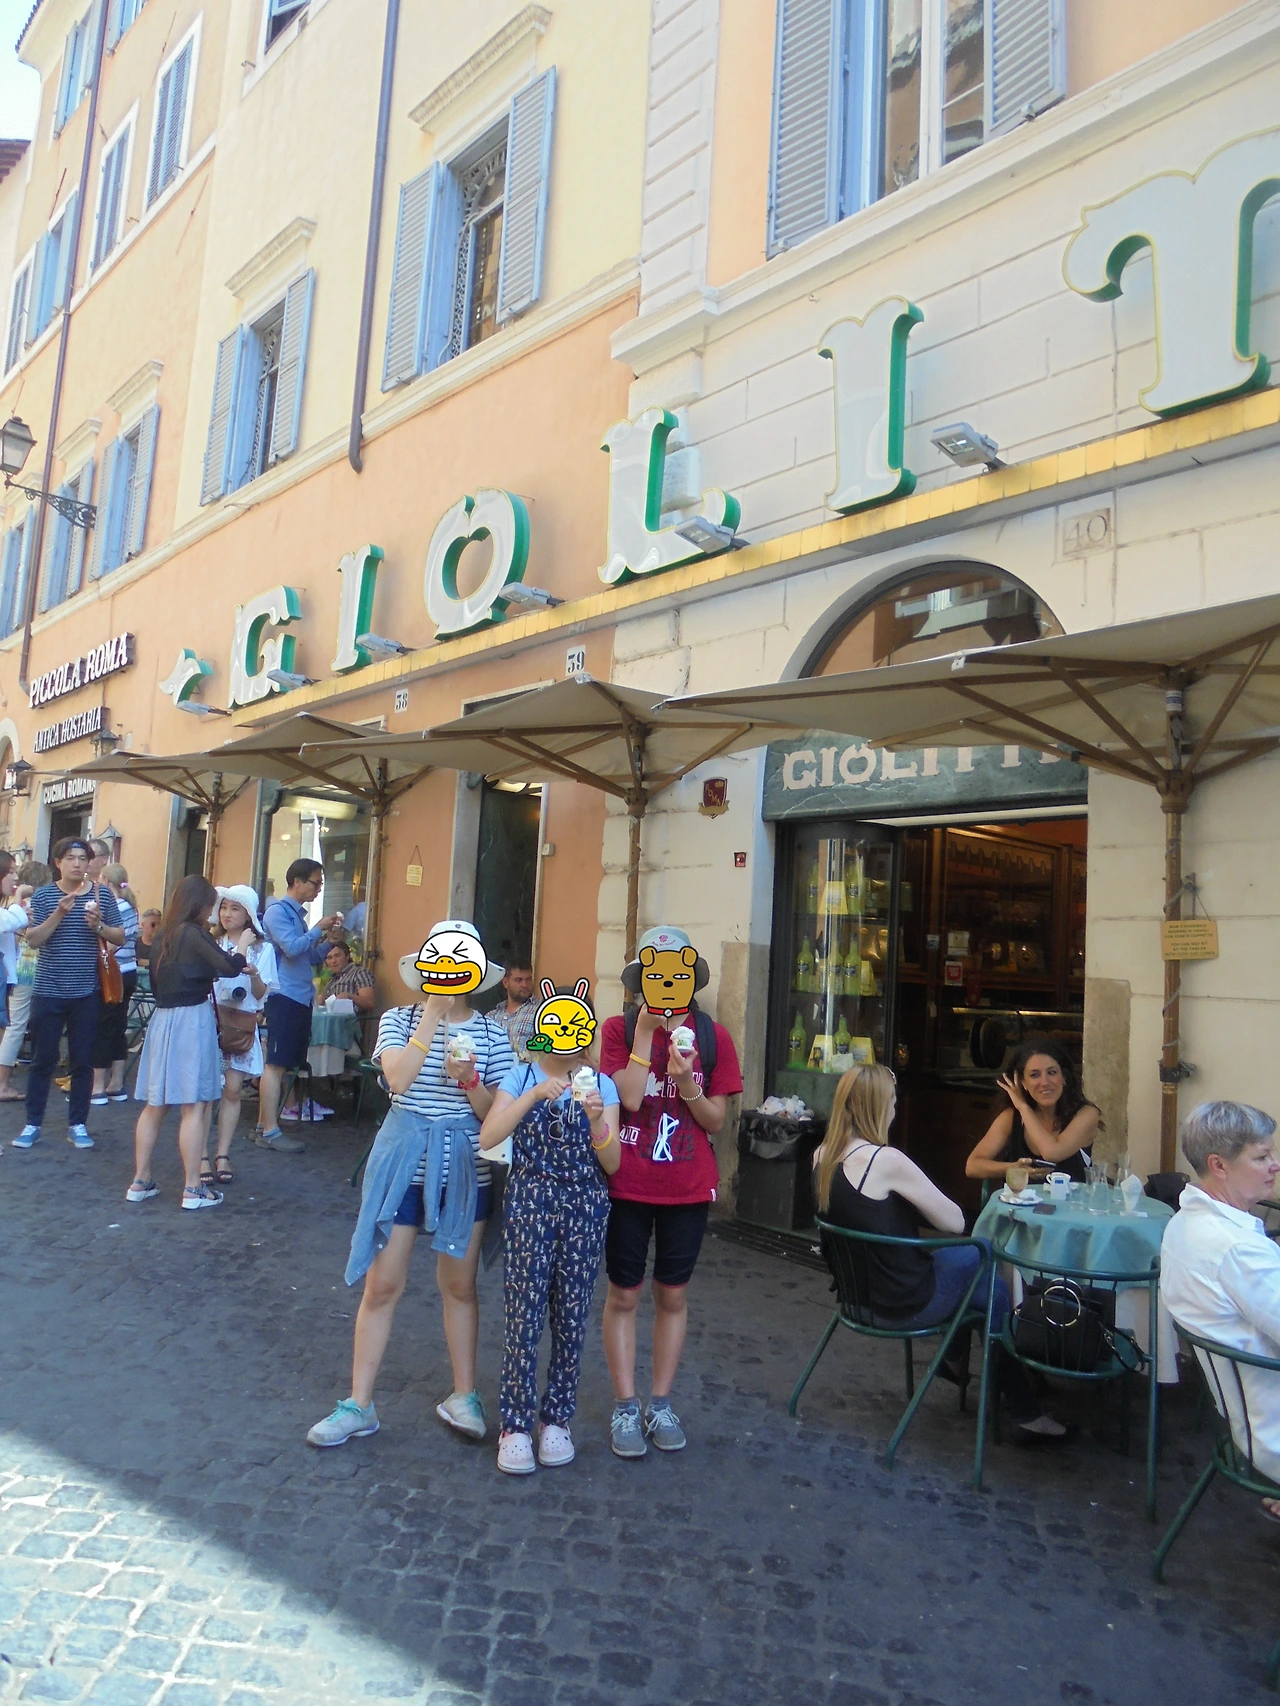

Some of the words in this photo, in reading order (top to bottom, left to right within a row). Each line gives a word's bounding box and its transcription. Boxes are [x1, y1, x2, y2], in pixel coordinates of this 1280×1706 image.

[1066, 514, 1107, 548] 40
[29, 657, 81, 708] PICCOLA
[84, 632, 127, 683] ROMA
[568, 651, 585, 673] 39
[396, 693, 407, 710] 38
[33, 723, 59, 753] ANTICA
[61, 706, 101, 744] HOSTARIA
[44, 782, 65, 804] CUCINA
